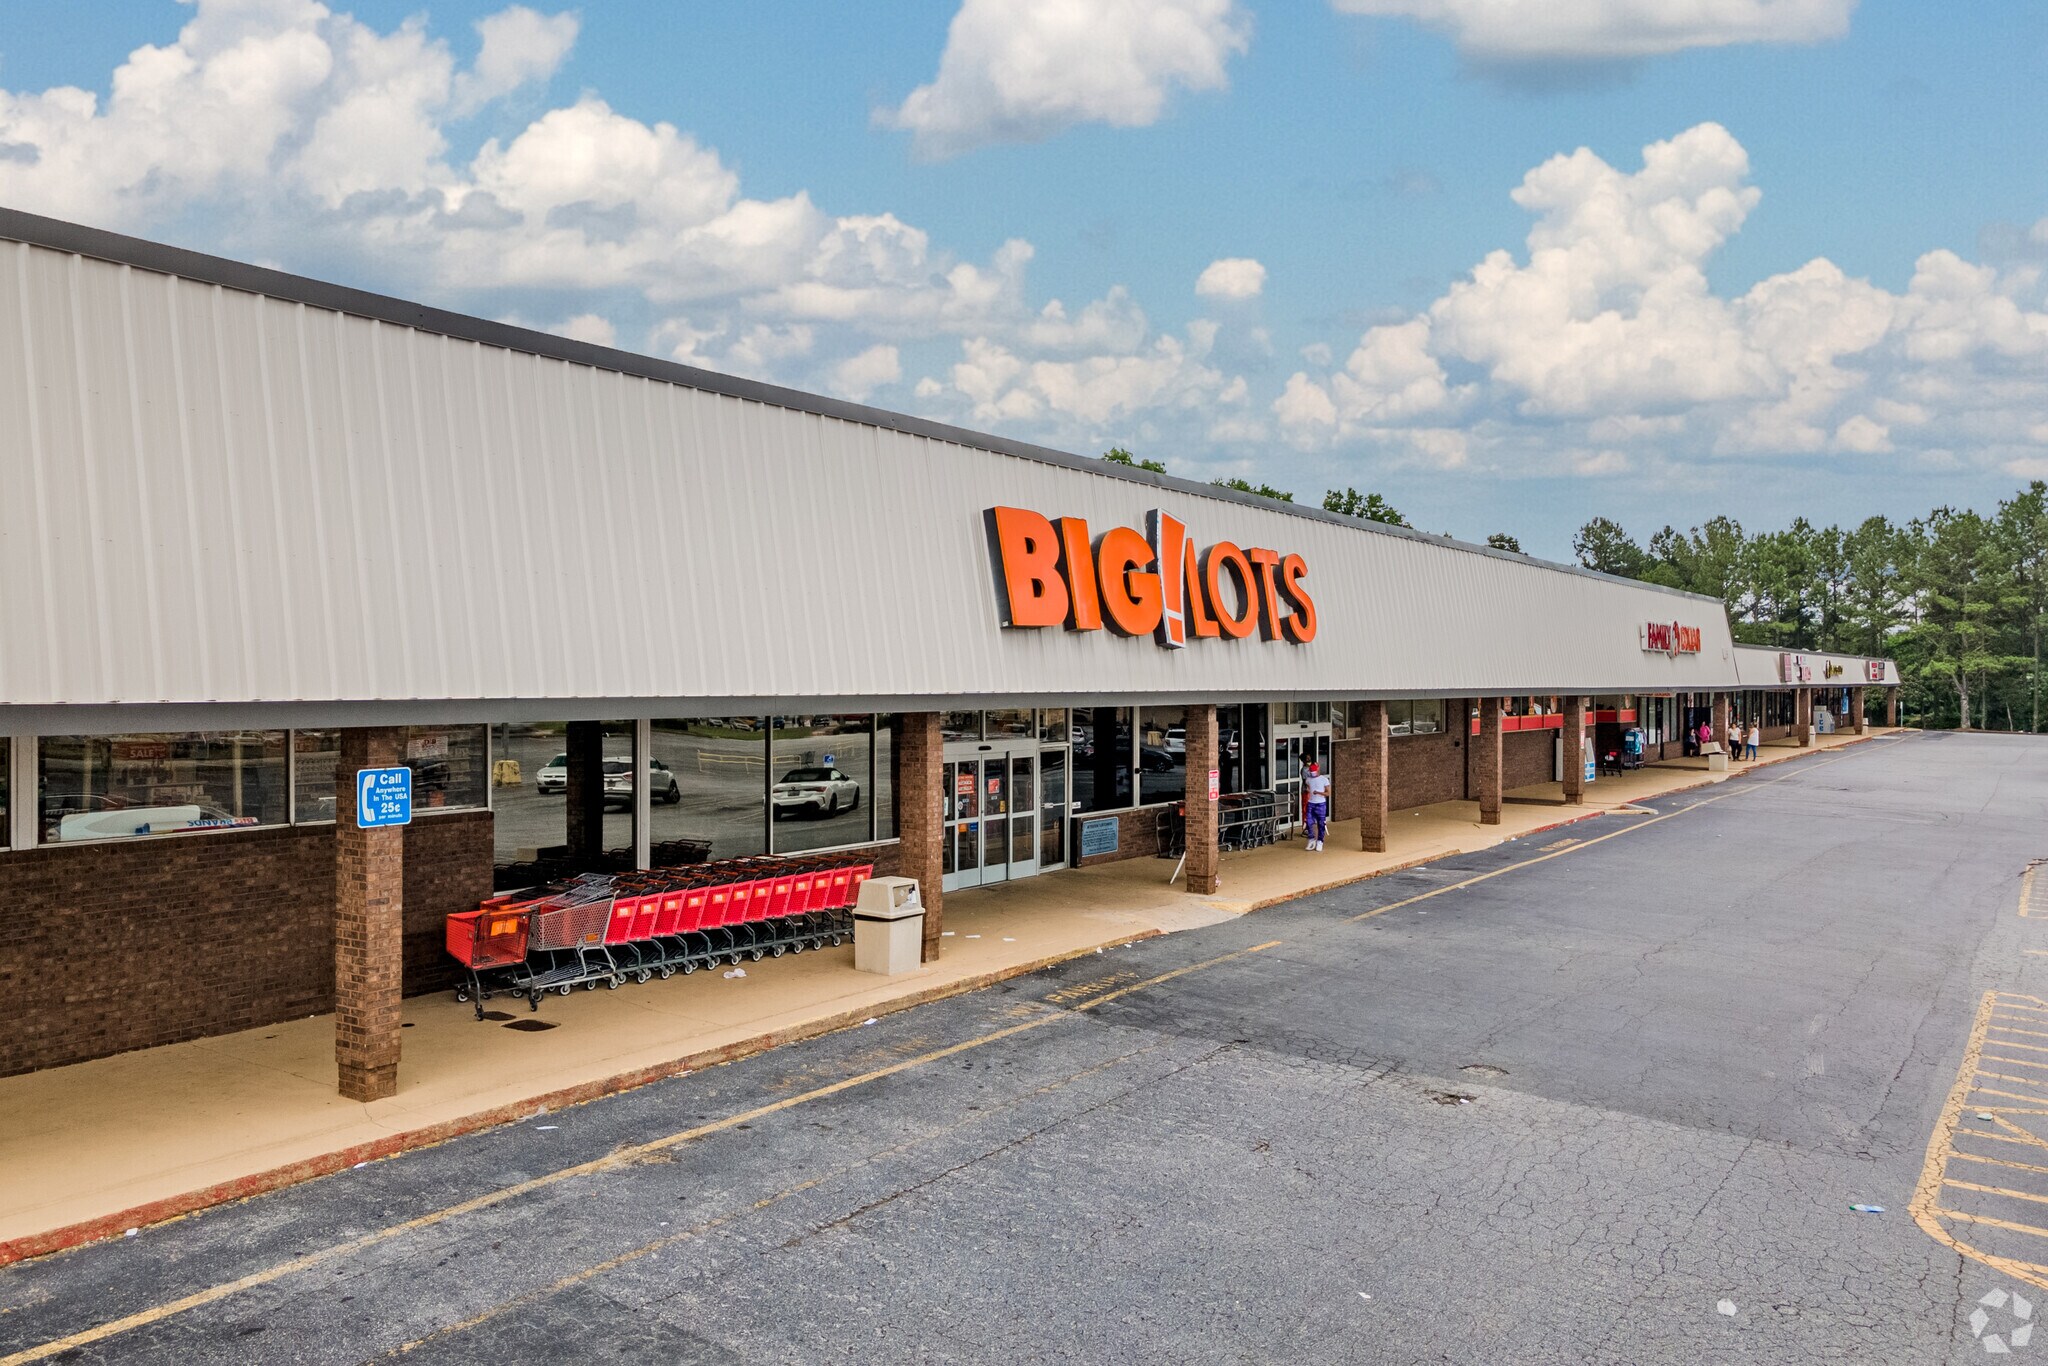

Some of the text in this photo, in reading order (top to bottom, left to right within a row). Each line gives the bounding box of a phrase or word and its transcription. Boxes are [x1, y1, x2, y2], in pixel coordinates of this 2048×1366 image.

[1647, 622, 1671, 650] FAMILY
[130, 749, 154, 758] SALE
[380, 773, 401, 784] Call
[375, 786, 406, 794] Anywhere
